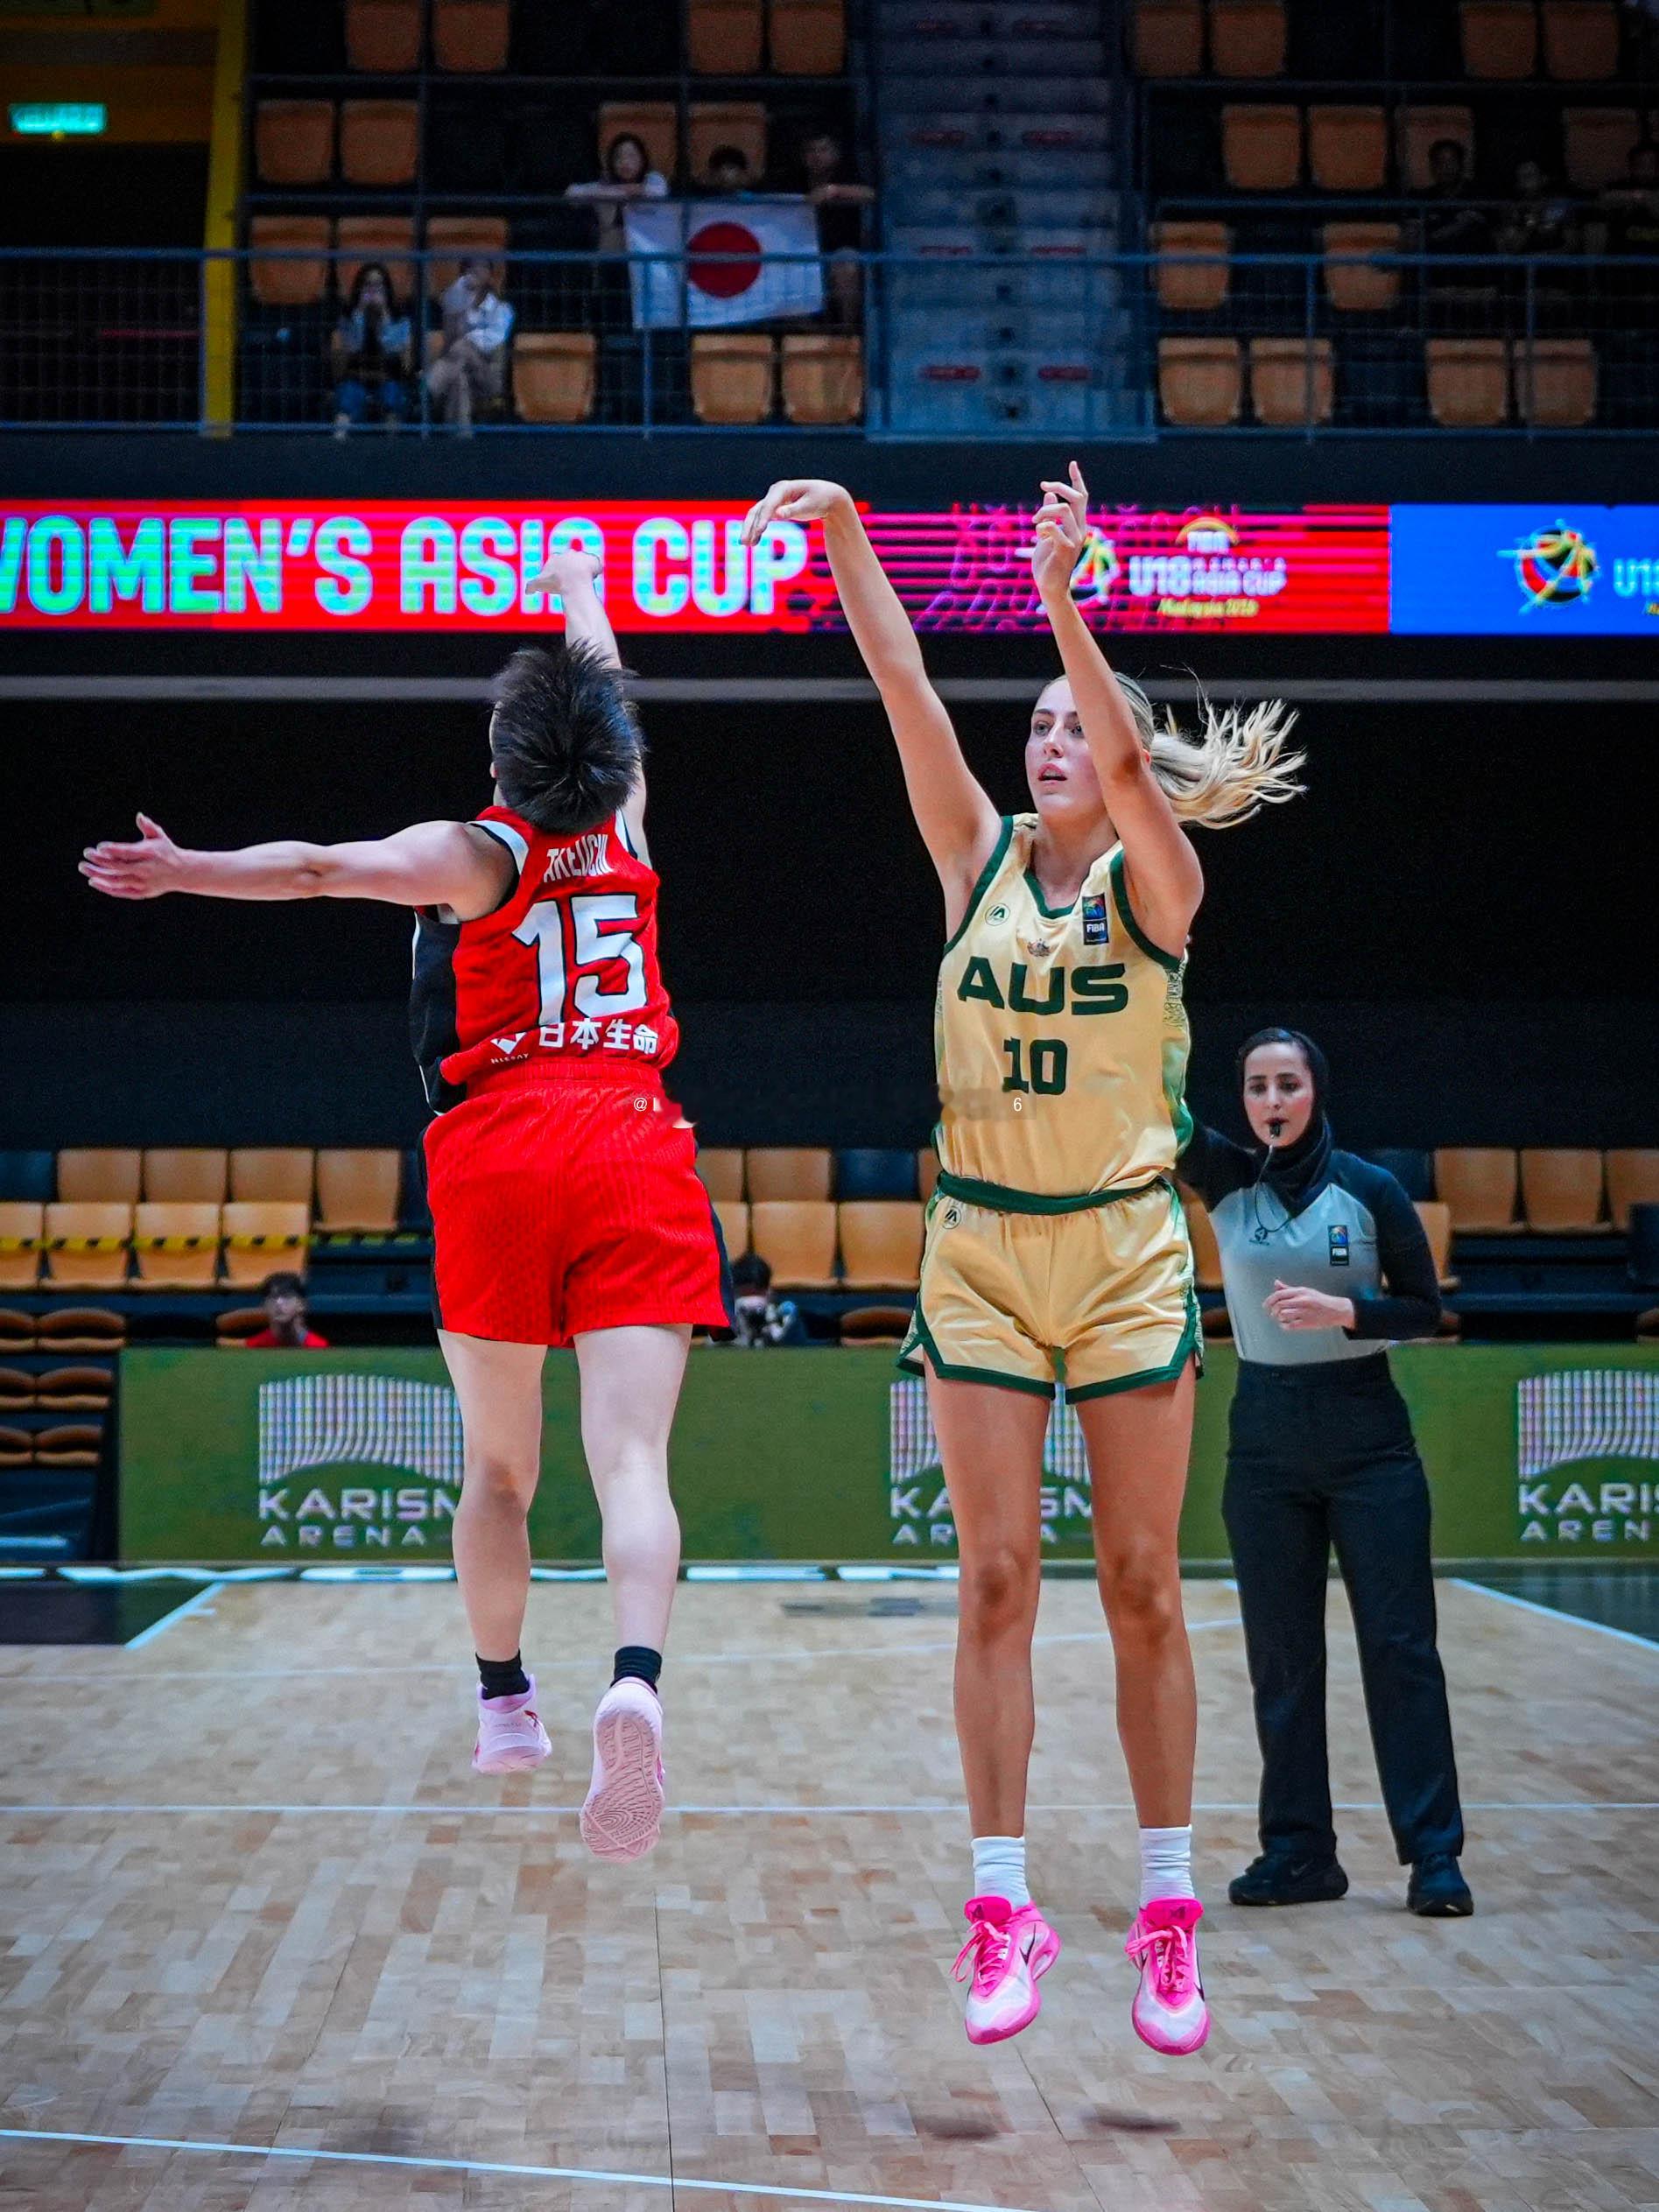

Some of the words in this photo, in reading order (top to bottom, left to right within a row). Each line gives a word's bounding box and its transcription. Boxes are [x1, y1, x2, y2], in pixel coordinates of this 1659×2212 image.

[0, 515, 374, 615] OMEN'S
[400, 516, 605, 615] ASIA
[632, 517, 808, 616] CUP
[1128, 556, 1192, 596] U18
[1086, 923, 1105, 933] FIBA
[511, 893, 648, 1027] 15
[957, 956, 1128, 1015] AUS
[538, 1018, 658, 1055] 日本生命
[1002, 1036, 1068, 1095] 10
[1519, 1484, 1659, 1515] KARI
[261, 1526, 427, 1547] ARENA
